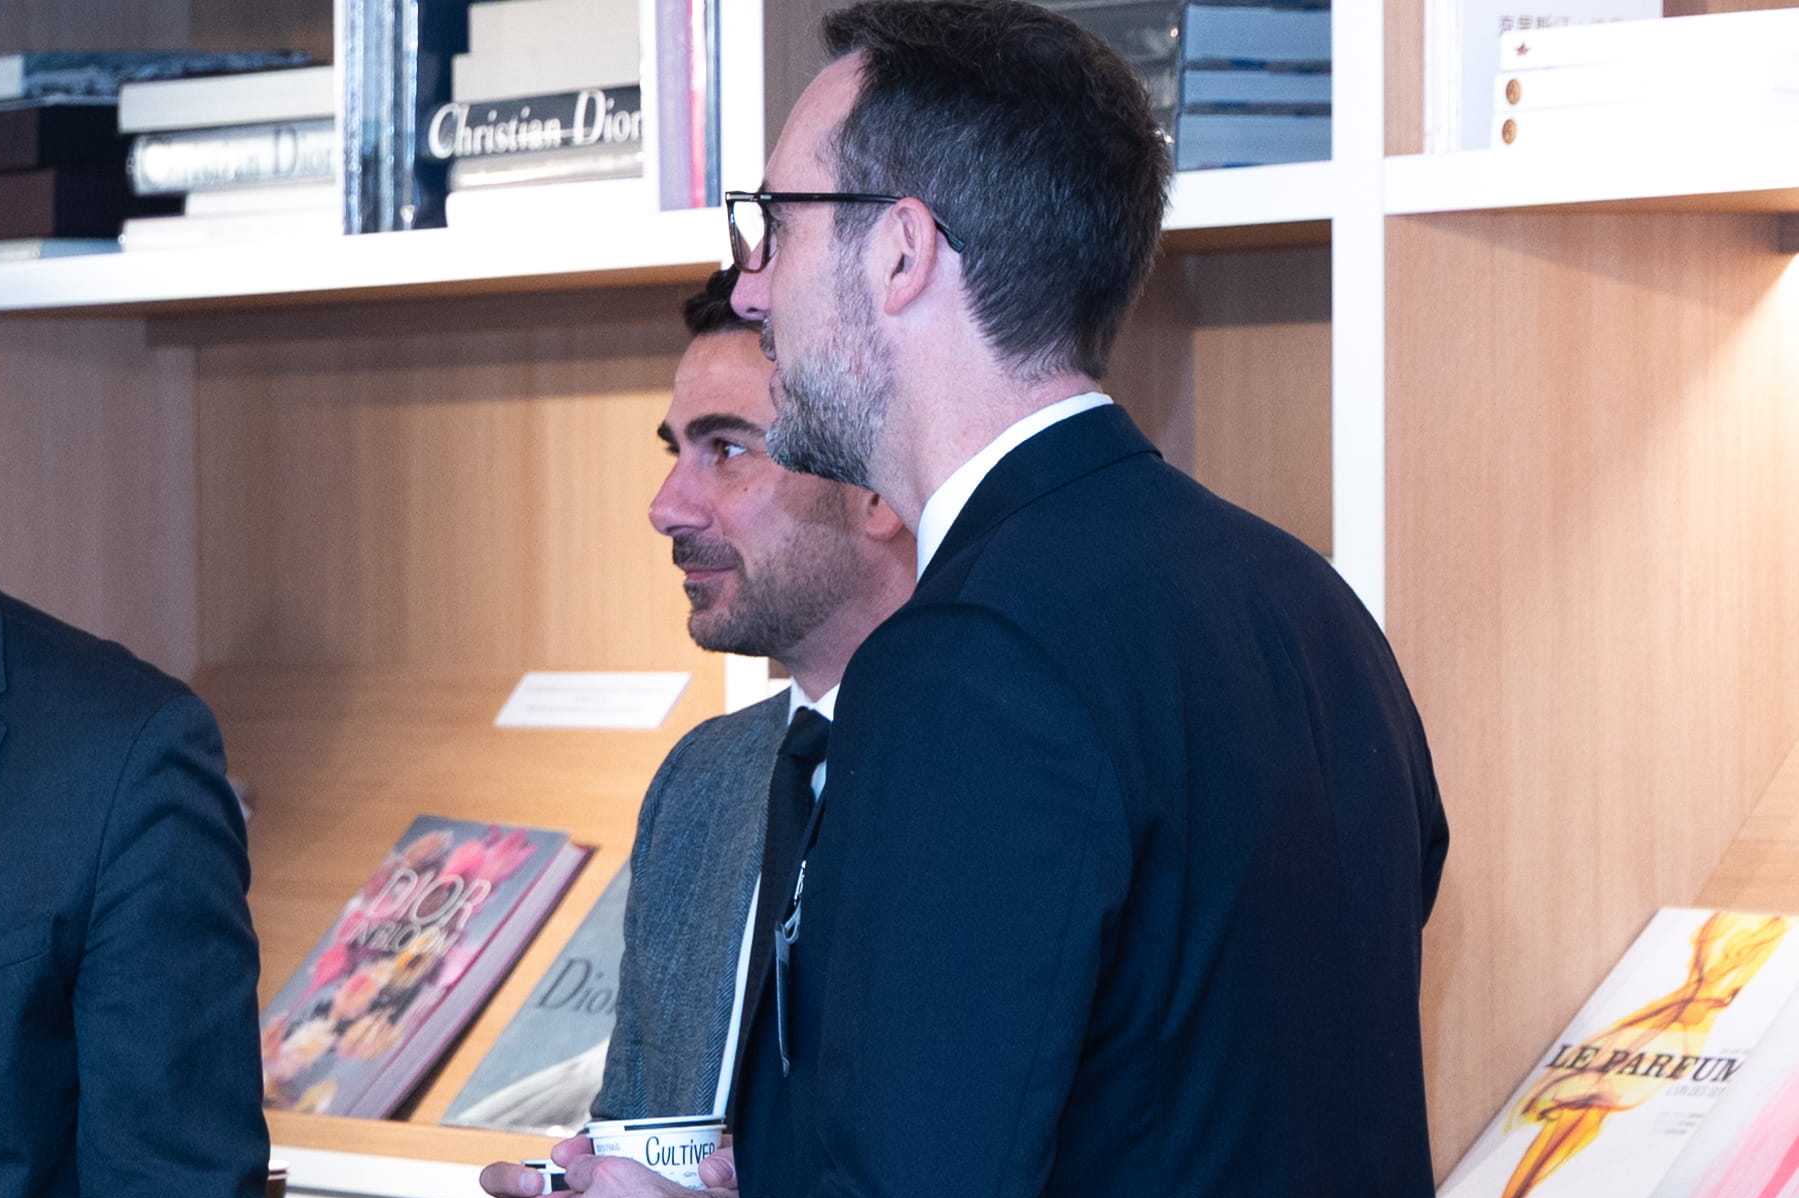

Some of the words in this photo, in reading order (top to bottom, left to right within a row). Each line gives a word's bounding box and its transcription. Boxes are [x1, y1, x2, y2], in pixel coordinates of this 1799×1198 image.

[428, 102, 562, 160] Christian
[573, 88, 642, 145] Dior
[366, 867, 492, 930] DIOR
[1546, 1044, 1599, 1071] LE
